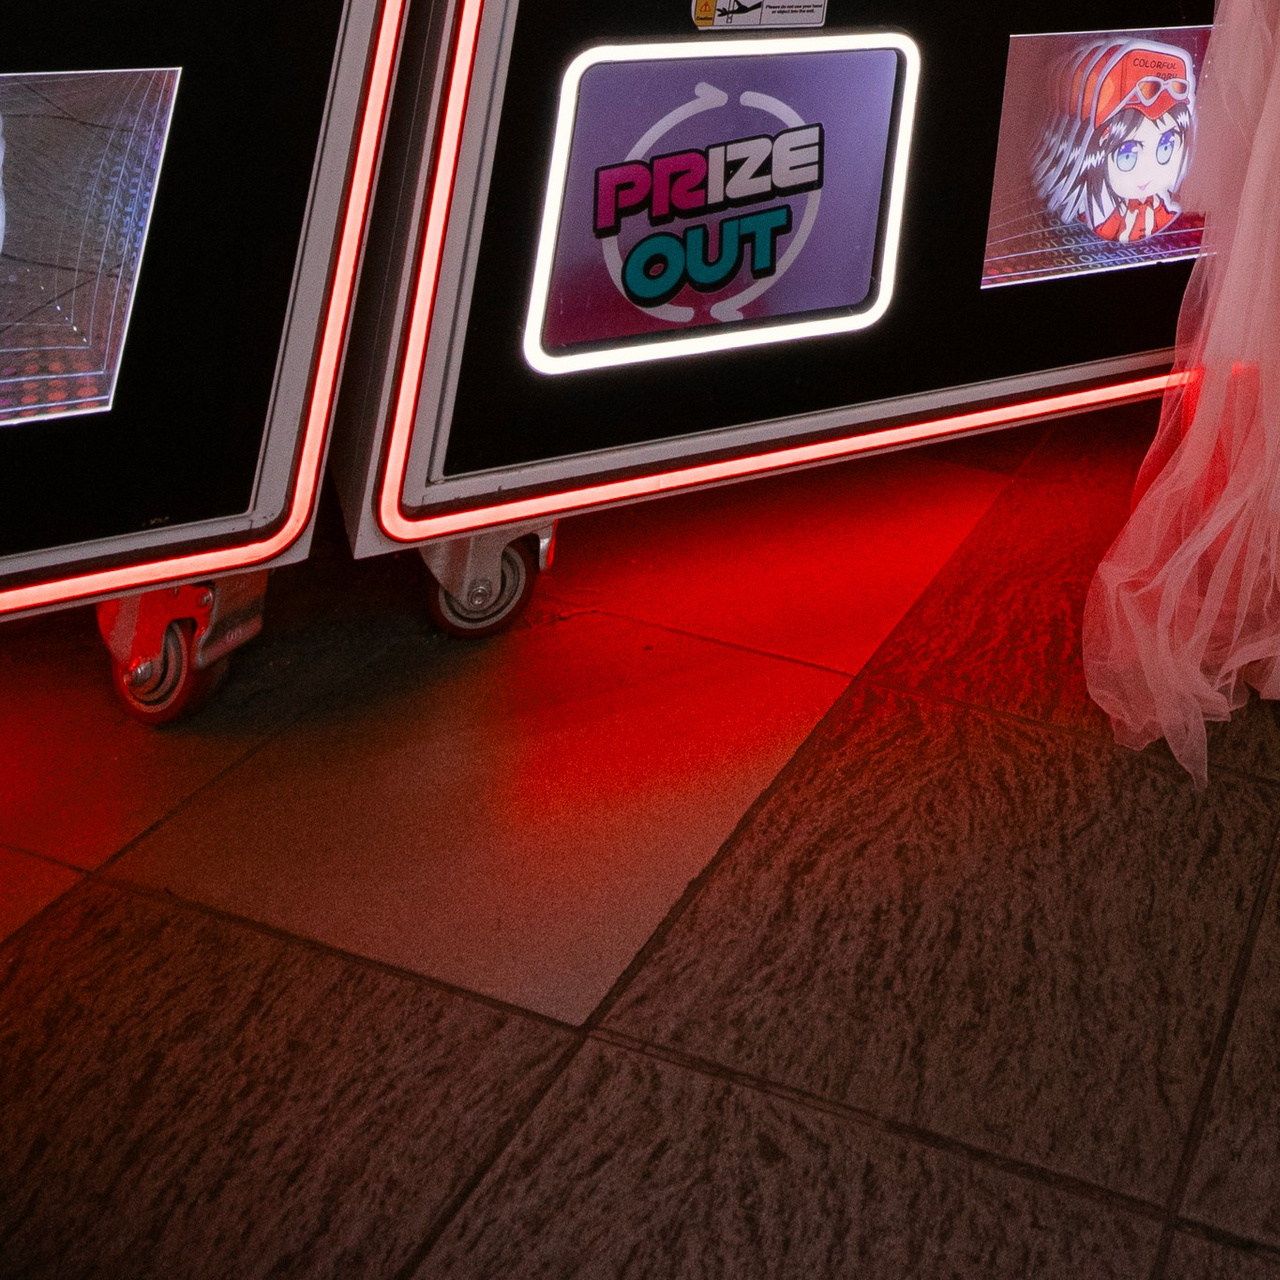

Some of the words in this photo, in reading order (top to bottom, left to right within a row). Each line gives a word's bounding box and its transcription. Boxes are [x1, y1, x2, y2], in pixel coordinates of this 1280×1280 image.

[1133, 58, 1177, 69] COLORFUL
[593, 123, 824, 239] PRIZE
[622, 204, 792, 308] OUT
